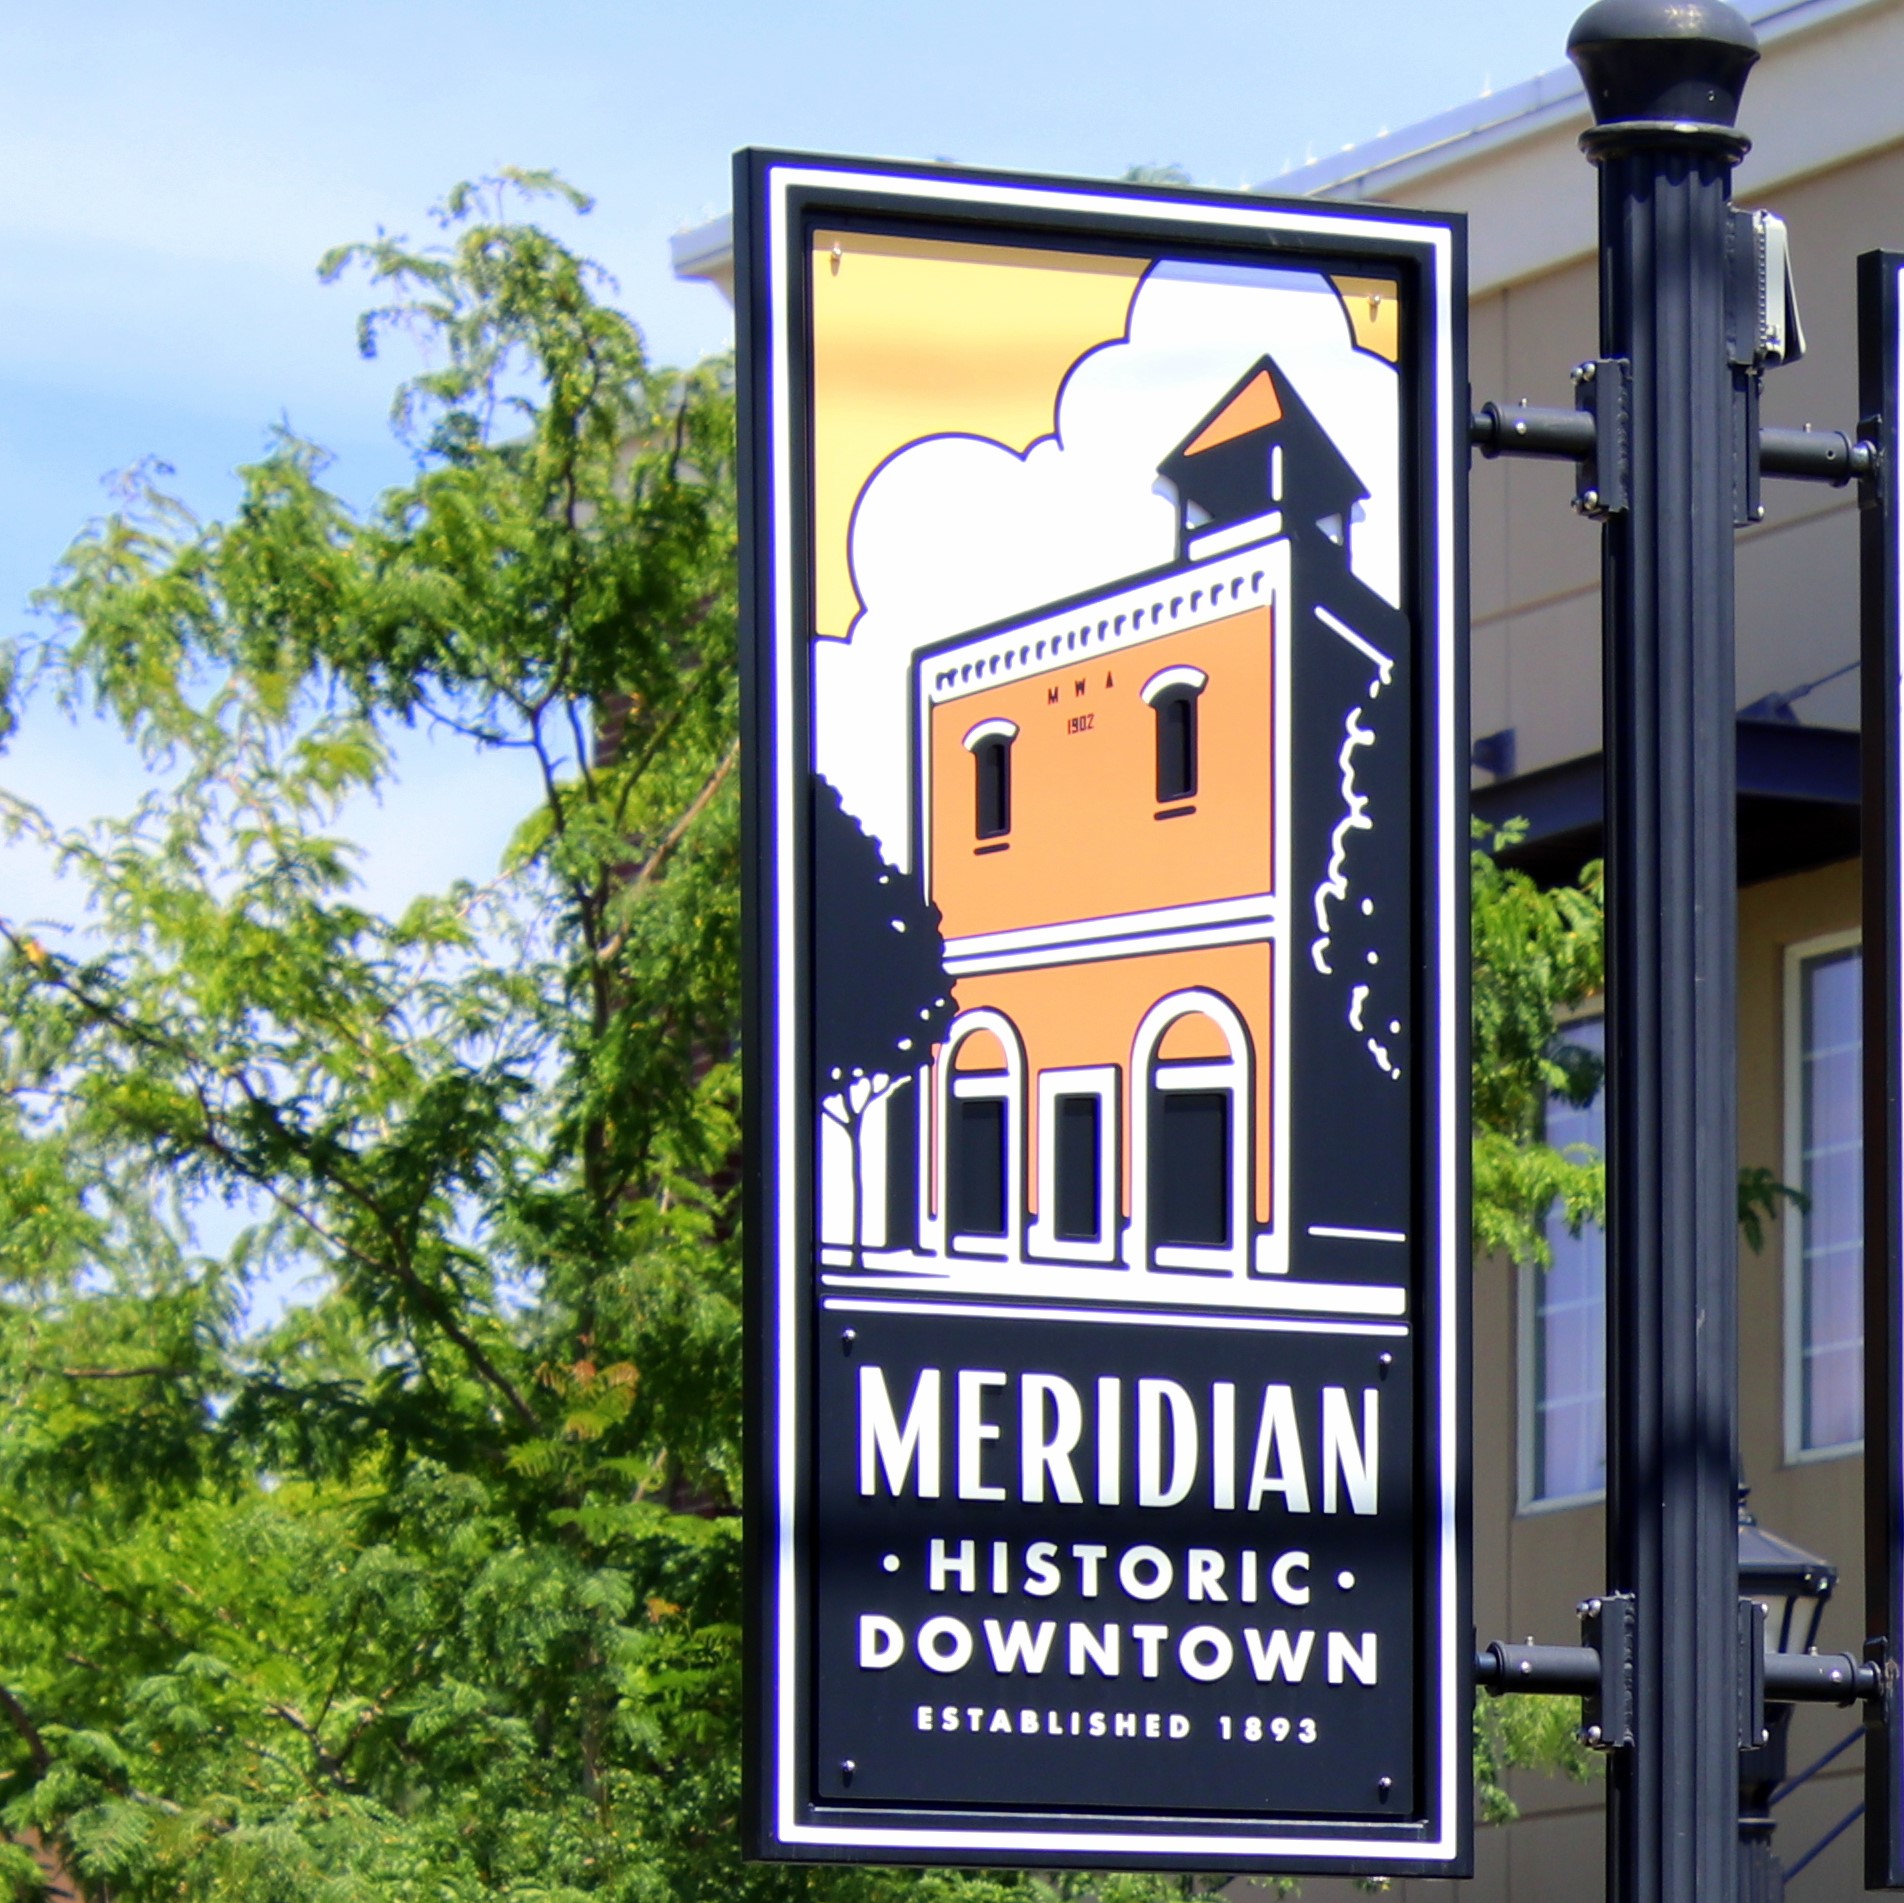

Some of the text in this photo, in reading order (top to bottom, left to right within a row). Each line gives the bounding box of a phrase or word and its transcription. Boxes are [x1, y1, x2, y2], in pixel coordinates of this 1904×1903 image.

[1067, 713, 1094, 735] 1902
[860, 1366, 1378, 1514] MERIDIAN
[930, 1539, 1309, 1605] HISTORIC
[860, 1615, 1377, 1684] DOWNTOWN
[918, 1706, 1317, 1744] ESTABLISHED 1893
